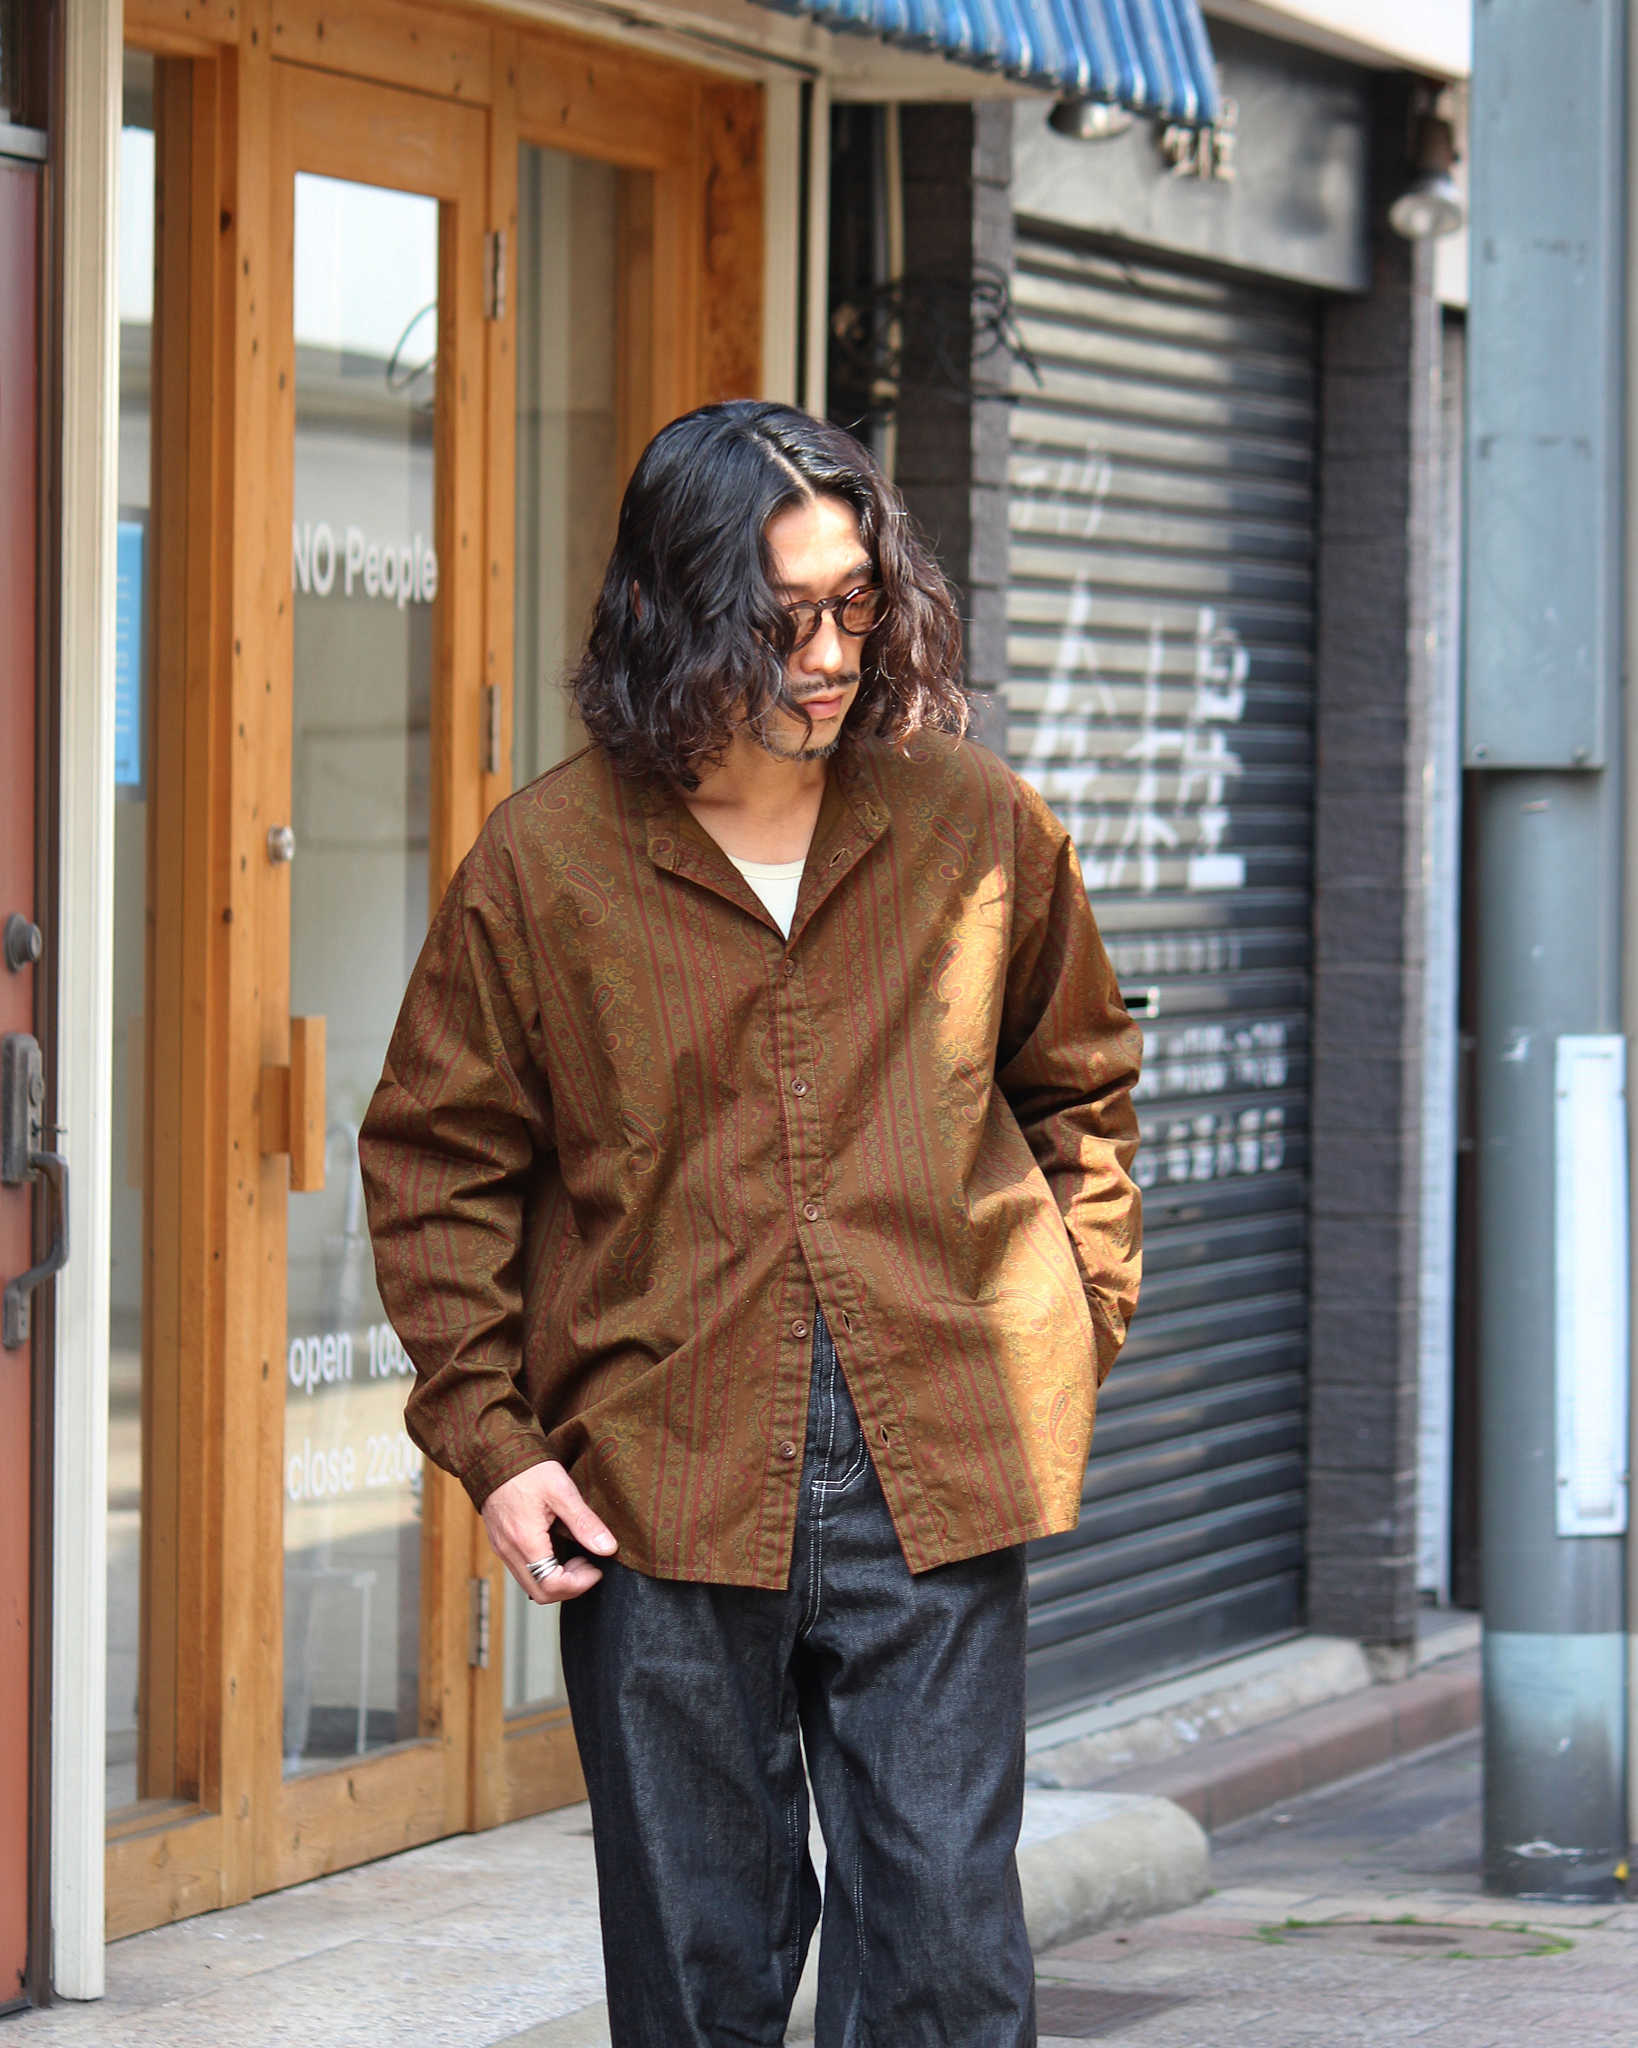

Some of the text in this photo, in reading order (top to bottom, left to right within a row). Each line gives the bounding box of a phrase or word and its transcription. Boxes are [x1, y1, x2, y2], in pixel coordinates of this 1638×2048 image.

[292, 521, 438, 609] NO People
[288, 1333, 352, 1395] open
[287, 1437, 354, 1501] close
